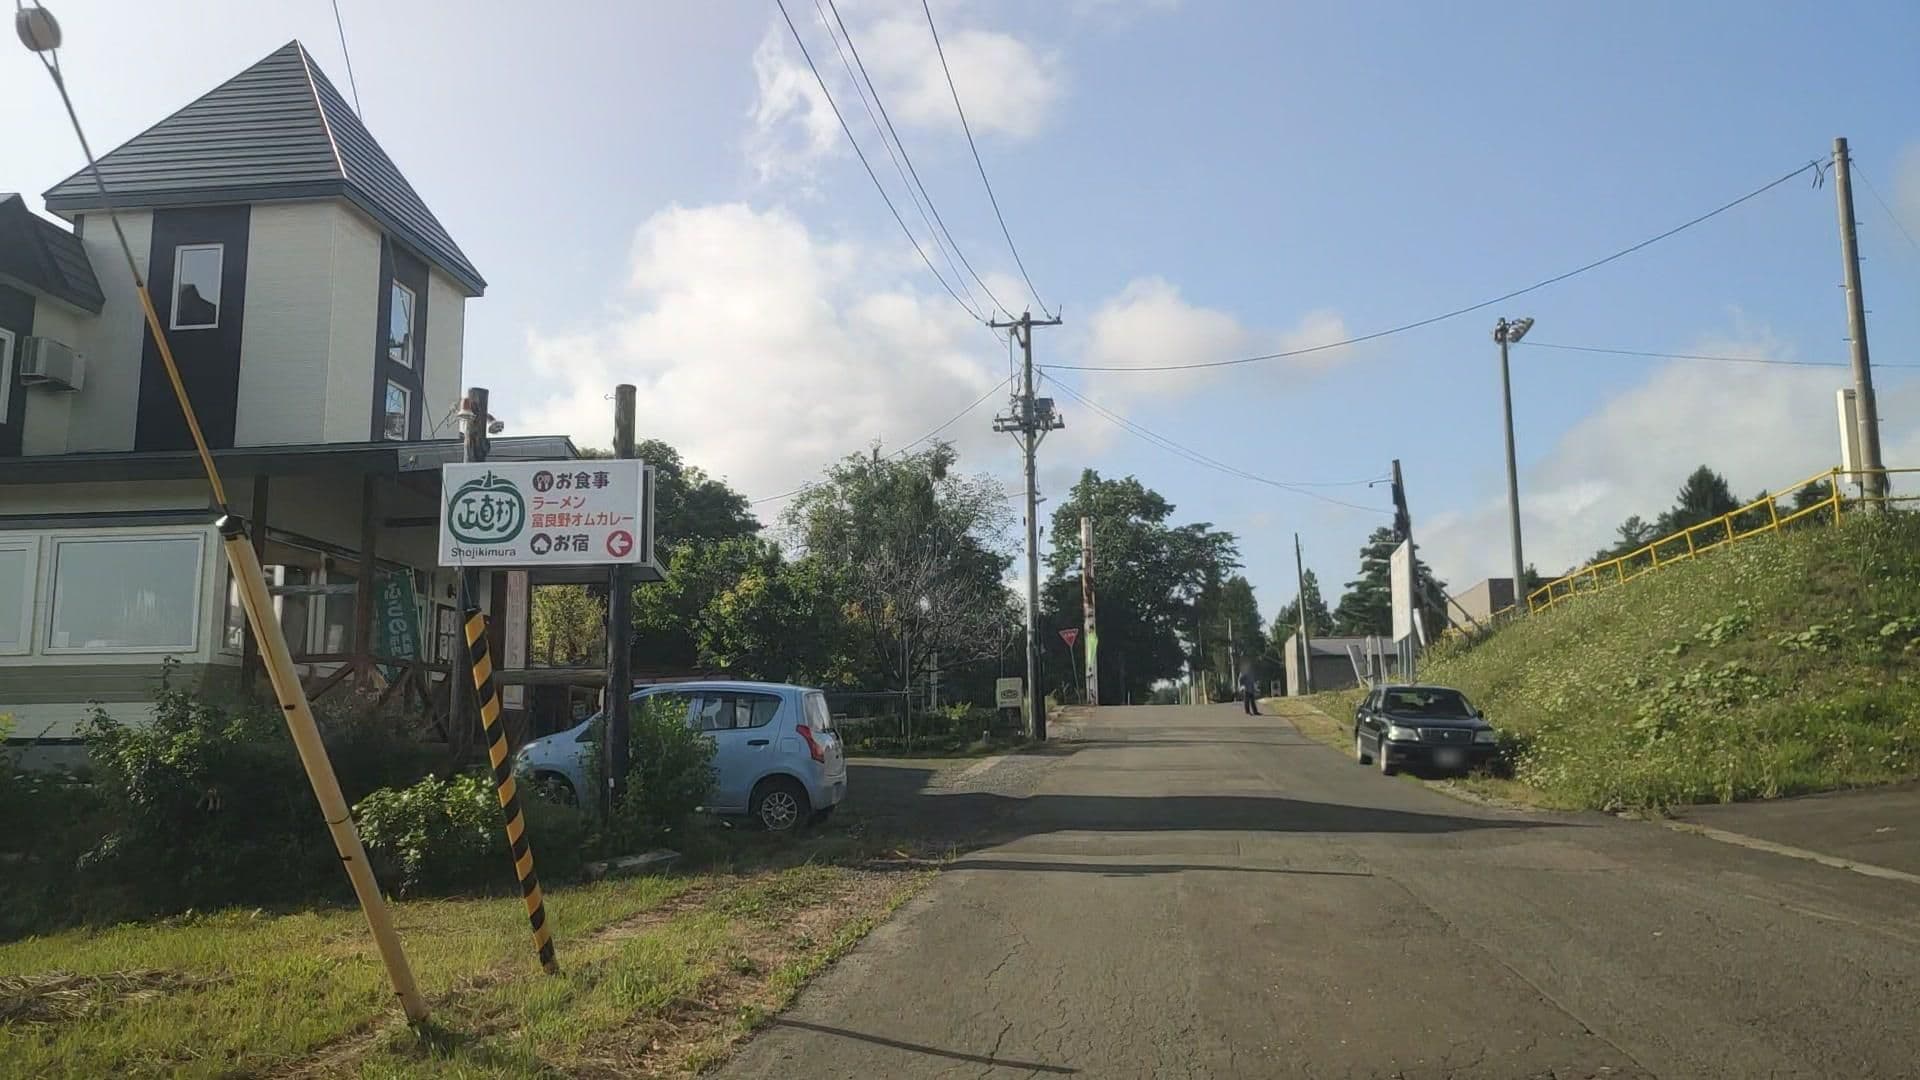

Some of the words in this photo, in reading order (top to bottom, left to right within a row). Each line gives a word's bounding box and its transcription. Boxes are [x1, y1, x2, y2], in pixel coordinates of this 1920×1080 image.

[556, 471, 611, 490] お食事
[532, 496, 586, 511] ラーメン
[532, 512, 635, 528] 富良野オムカレー
[554, 533, 590, 552] お宿
[450, 547, 517, 560] Shojikimura
